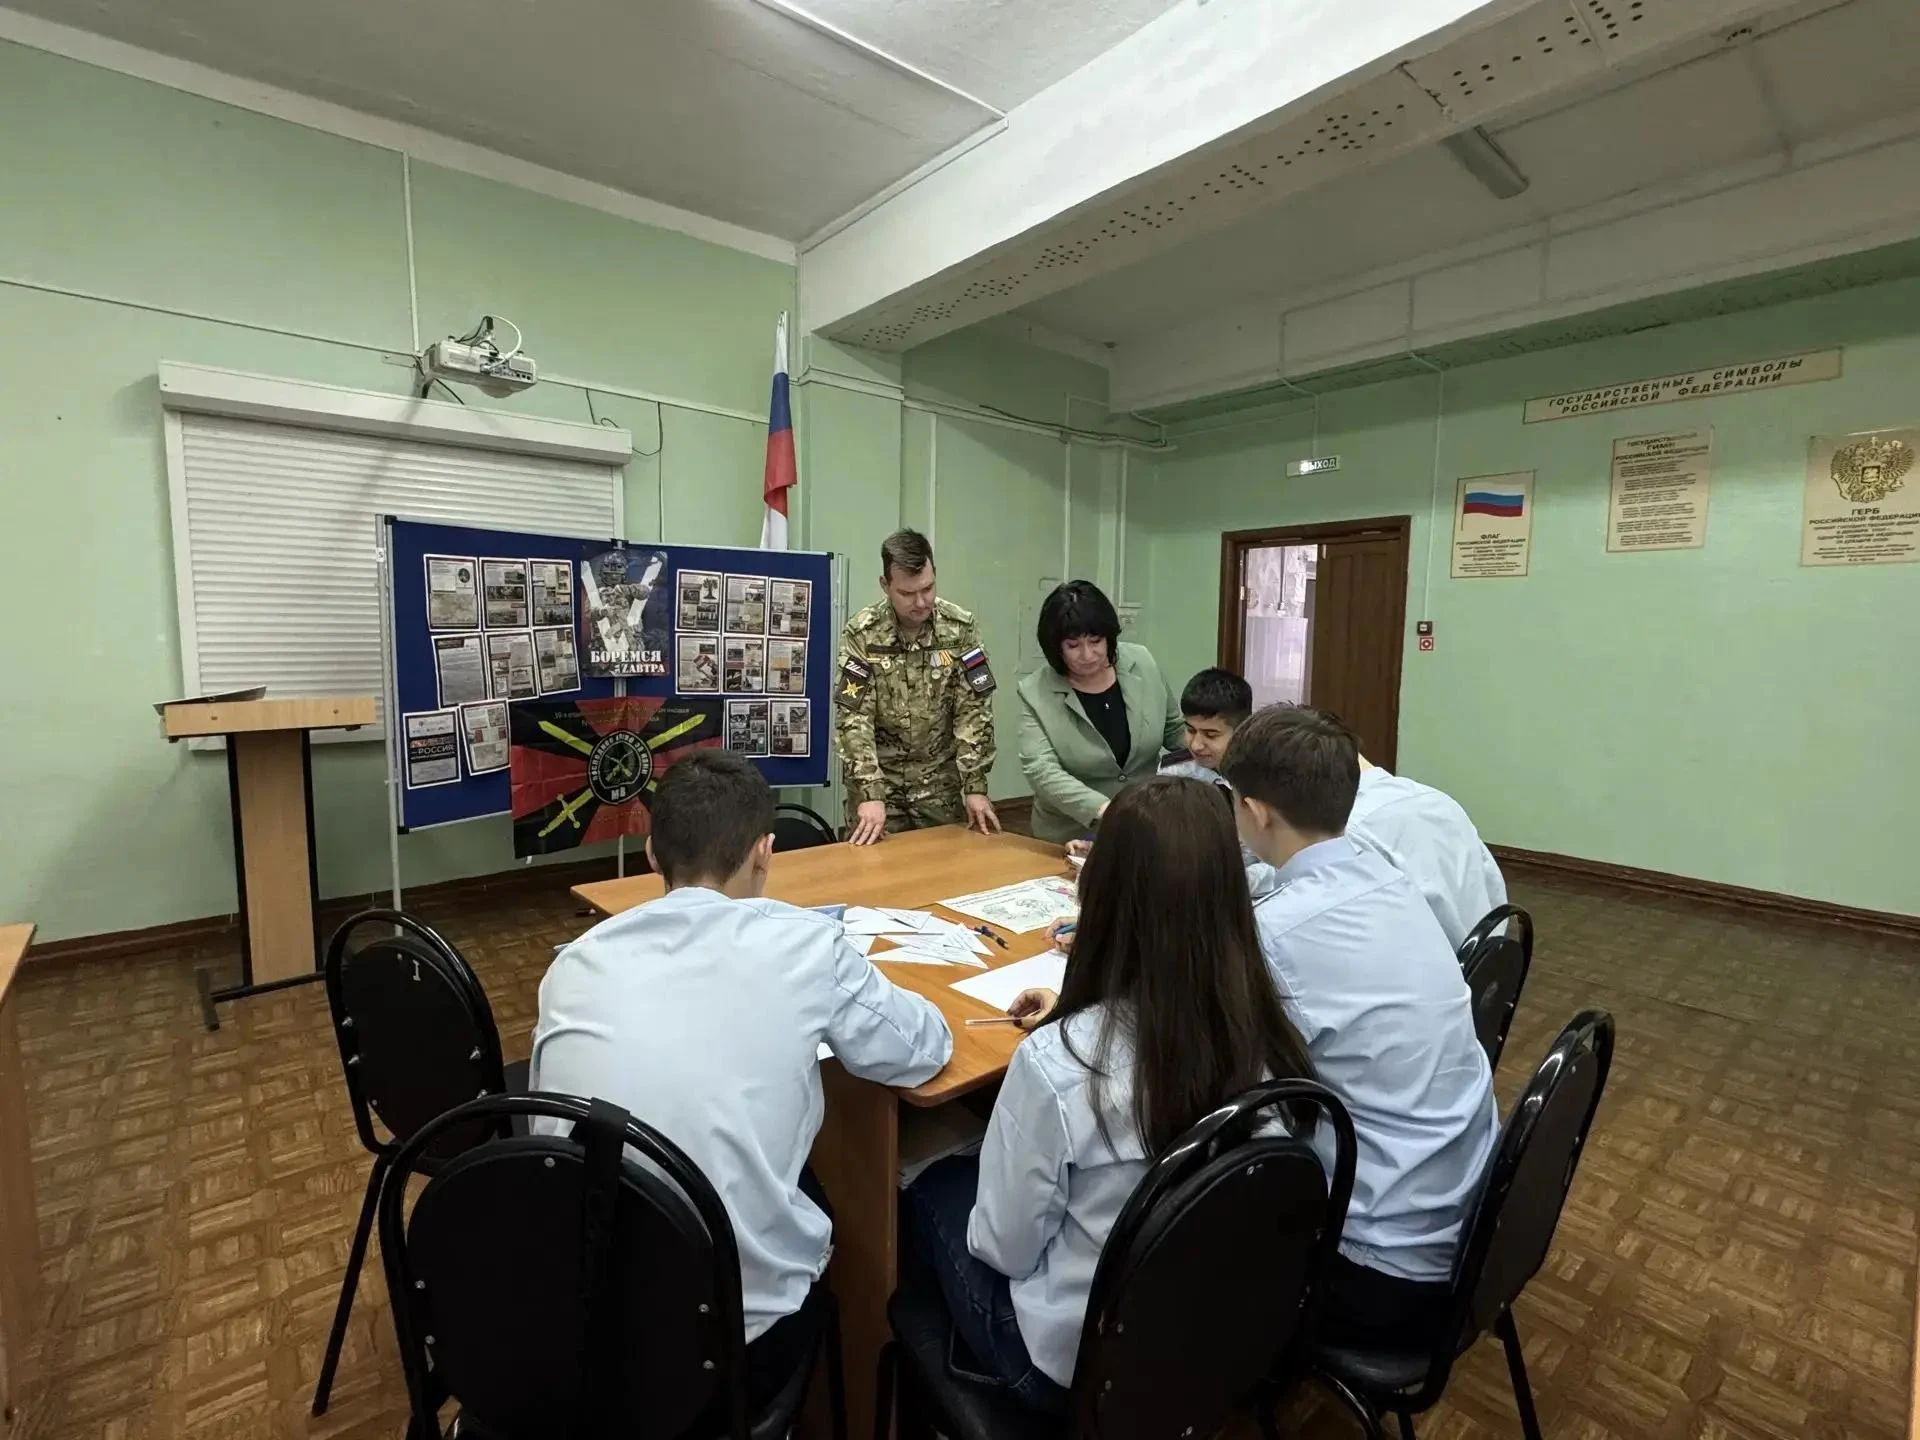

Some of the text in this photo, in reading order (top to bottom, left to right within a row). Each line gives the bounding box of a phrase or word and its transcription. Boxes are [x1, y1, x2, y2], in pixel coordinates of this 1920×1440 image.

[1549, 358, 1803, 407] ГОСУДАРСТВЕННЫЕ СИМВОЛЫ
[1561, 372, 1783, 414] РОССИЙСКОЙ ФЕДЕРАЦИИ
[1851, 507, 1880, 515] ГЕРБ
[590, 650, 662, 663] БОРЕМСЯ
